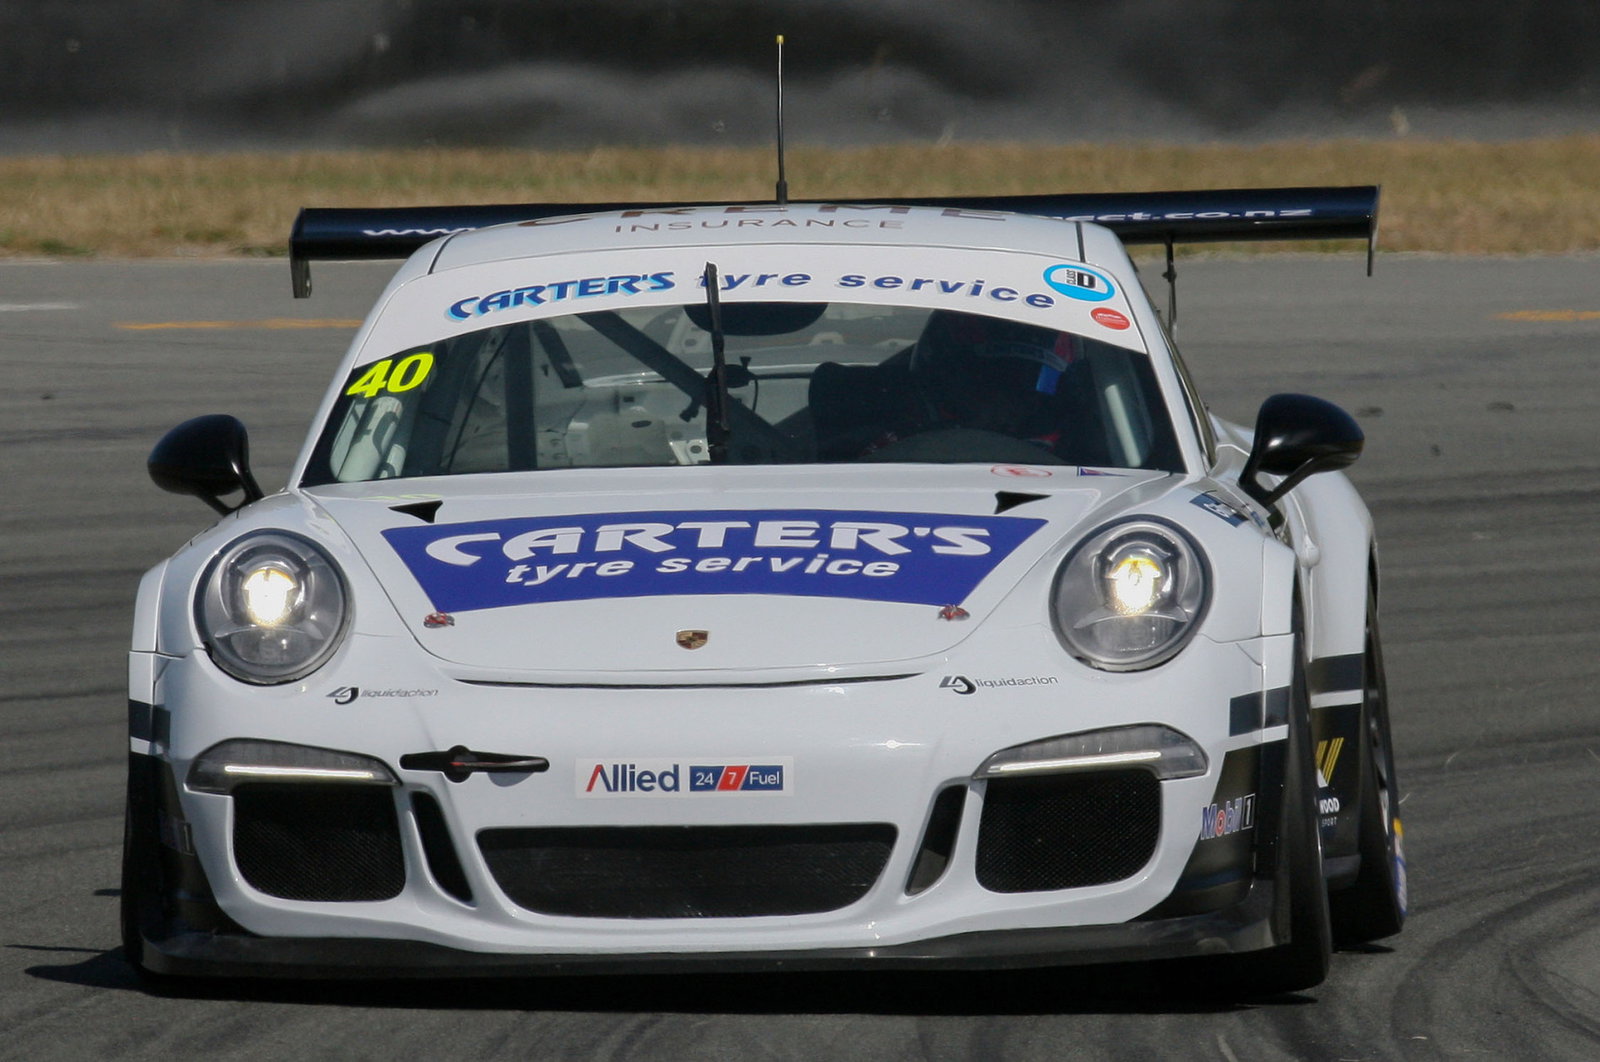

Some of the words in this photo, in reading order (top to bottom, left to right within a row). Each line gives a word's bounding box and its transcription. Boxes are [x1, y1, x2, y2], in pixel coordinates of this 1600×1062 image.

[614, 218, 904, 233] INSURANCE
[446, 271, 676, 321] CARTER'S
[838, 271, 1054, 309] service
[346, 353, 434, 398] 40
[425, 519, 992, 566] CARTER'S
[506, 554, 630, 586] tyre
[656, 551, 901, 577] service
[975, 675, 1058, 687] liquidaction
[586, 764, 680, 792] Allied
[695, 772, 714, 786] 24
[749, 771, 780, 785] Fuel
[1201, 797, 1242, 840] Mobil
